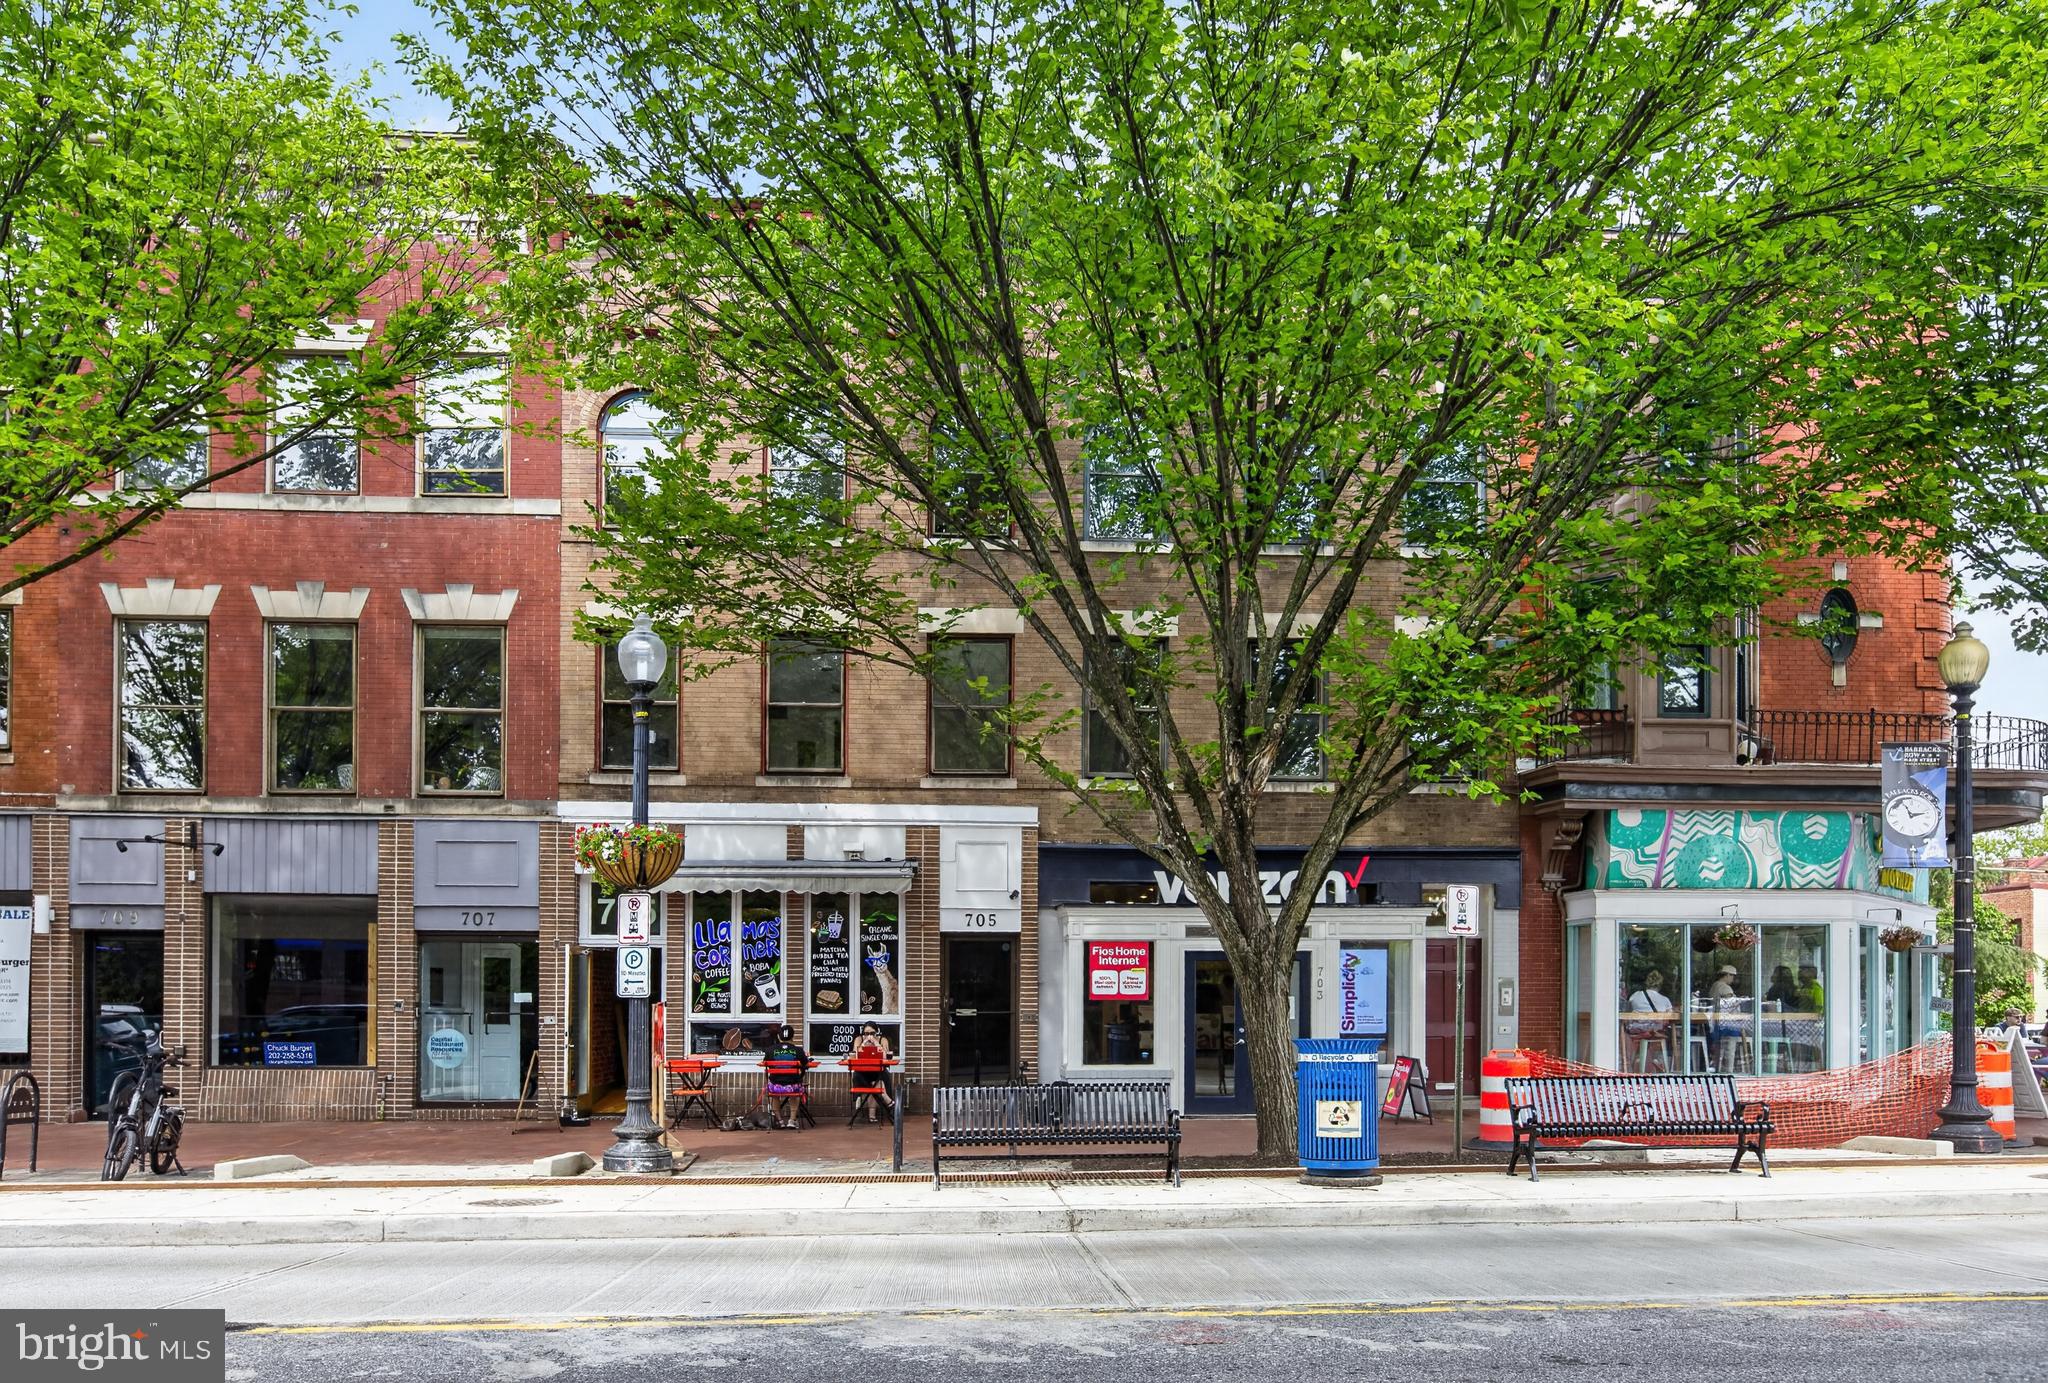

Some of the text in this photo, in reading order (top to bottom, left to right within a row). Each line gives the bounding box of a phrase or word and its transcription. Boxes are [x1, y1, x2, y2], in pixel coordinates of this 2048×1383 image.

[461, 911, 496, 926] 707
[965, 913, 997, 928] 705
[1092, 946, 1146, 956] Fios Home
[0, 959, 29, 968] urger
[1098, 956, 1140, 966] Internet
[704, 968, 731, 979] COFFEE
[749, 962, 770, 973] BOBA
[1341, 952, 1358, 1031] Simplicity
[833, 1025, 855, 1034] GOOD
[832, 1034, 853, 1043] GOOD
[828, 1044, 850, 1053] GOOD
[1318, 1054, 1345, 1062] Recycle
